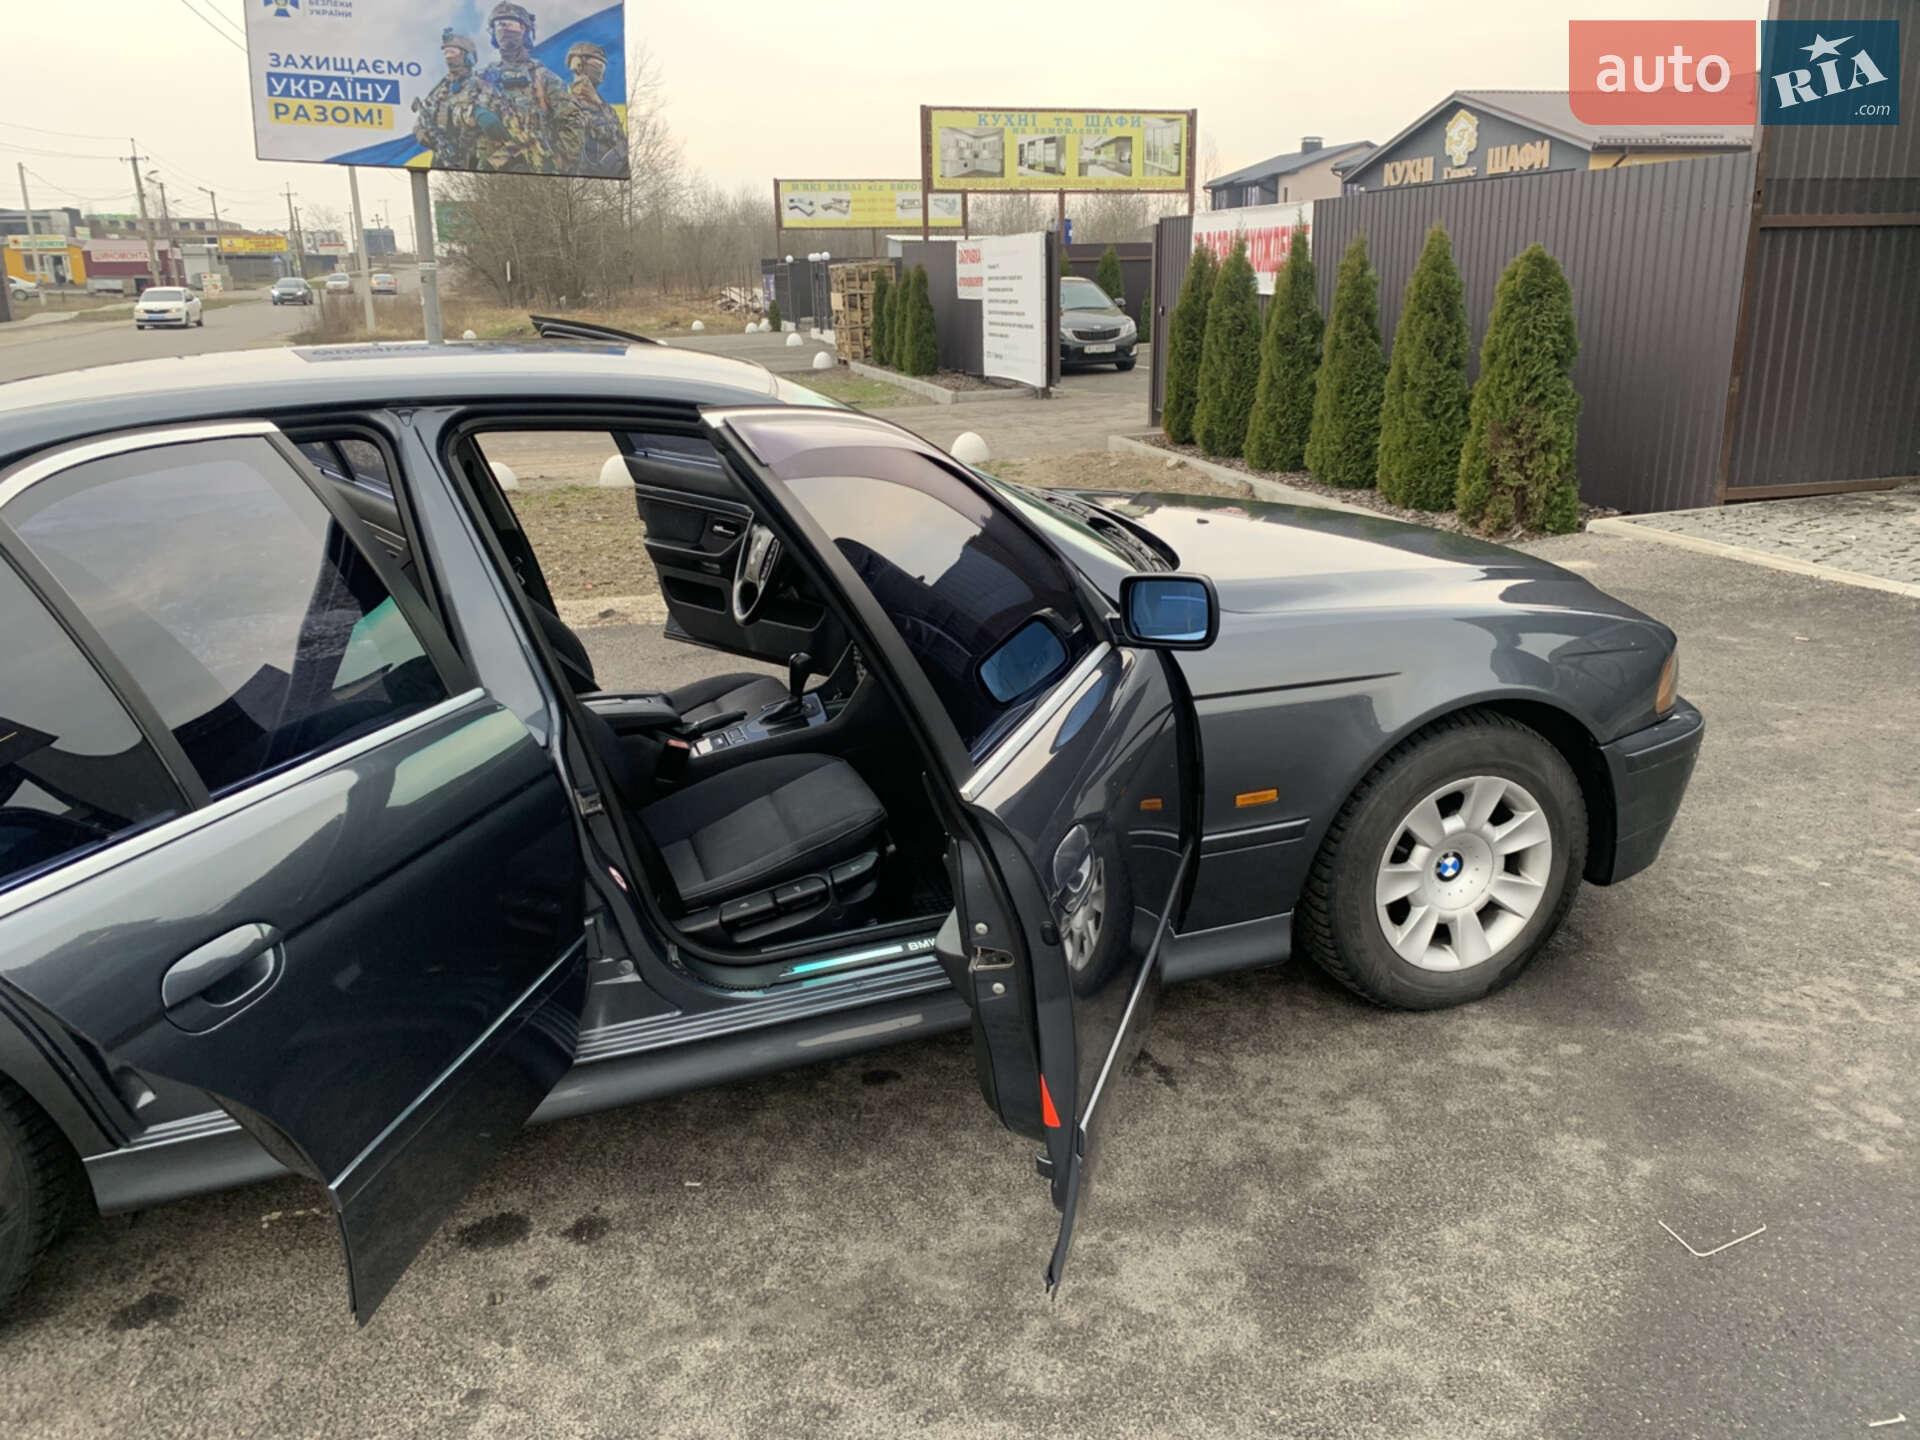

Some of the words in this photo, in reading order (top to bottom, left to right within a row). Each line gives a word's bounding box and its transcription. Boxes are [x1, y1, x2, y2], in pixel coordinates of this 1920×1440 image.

[308, 9, 352, 18] УКРАЇНИ
[268, 52, 423, 77] ЗАХИЩАЄМО
[270, 76, 392, 102] УКРАЇНУ
[273, 103, 383, 126] РАЗОМ!
[977, 113, 1037, 127] КУХНІ
[1053, 118, 1073, 128] та
[1085, 115, 1144, 128] ШАФИ
[1486, 139, 1551, 175] ШАФИ
[1383, 156, 1434, 187] КУХНІ
